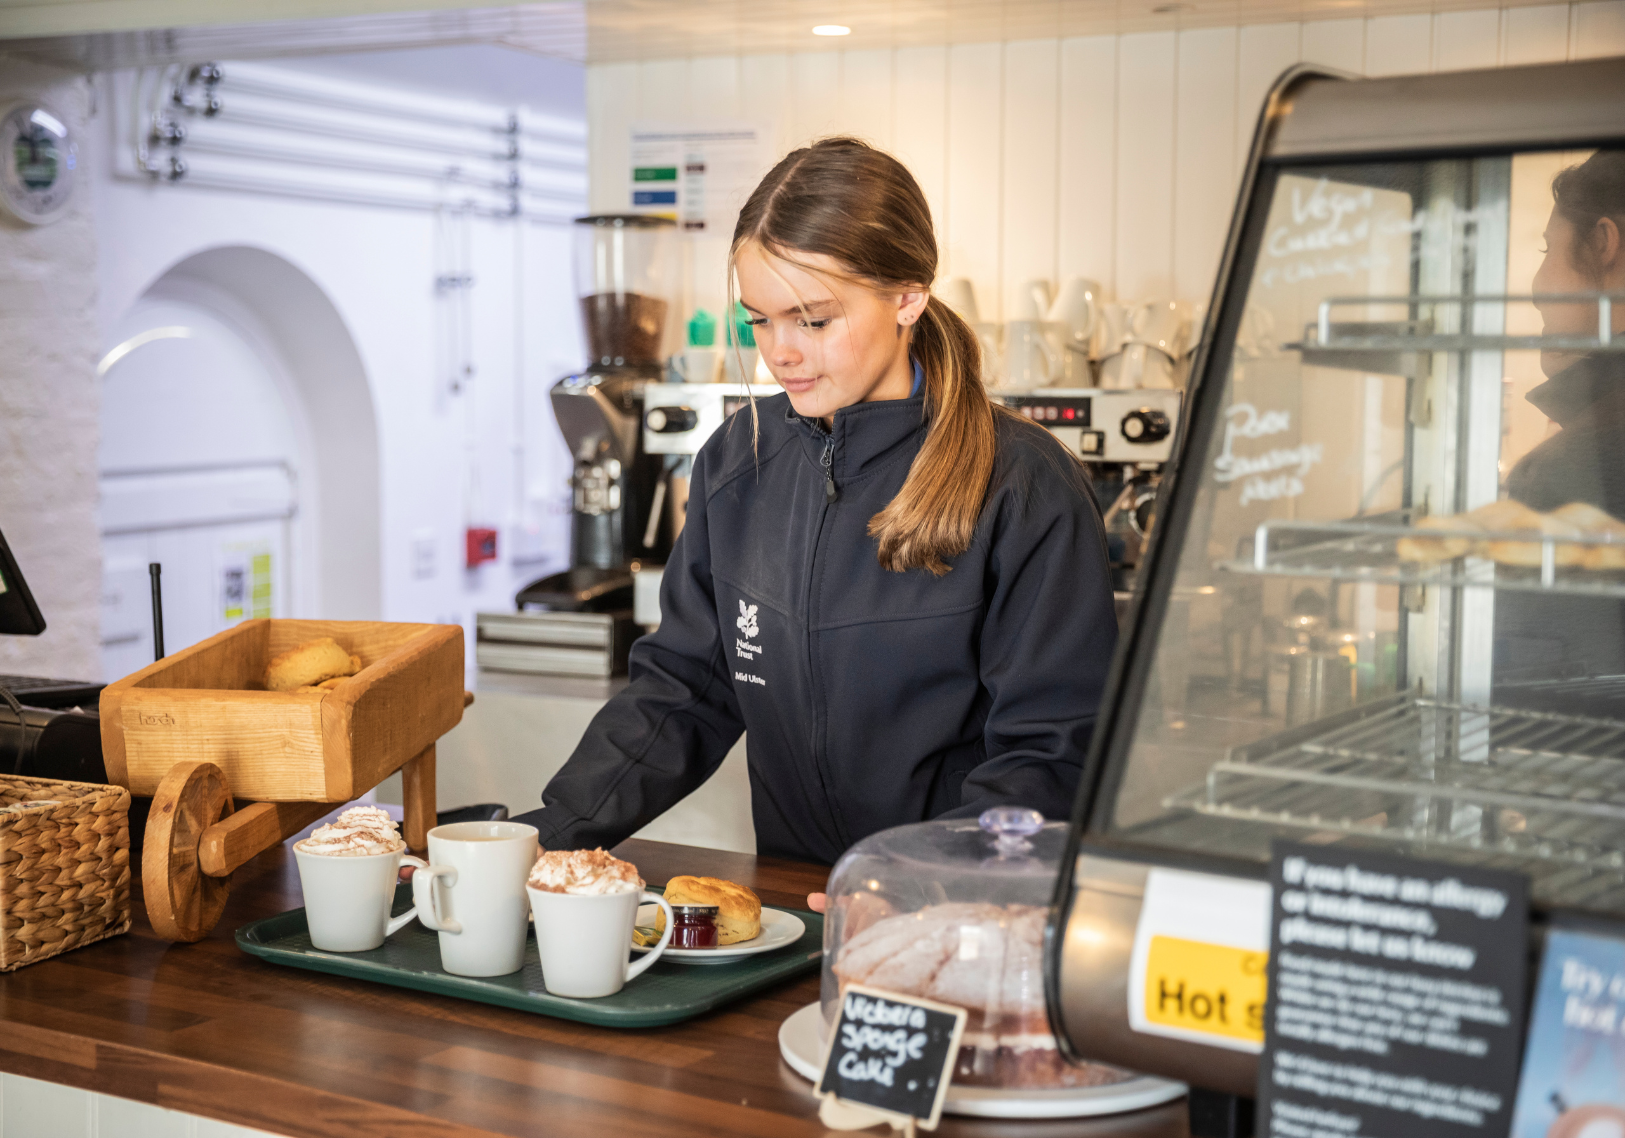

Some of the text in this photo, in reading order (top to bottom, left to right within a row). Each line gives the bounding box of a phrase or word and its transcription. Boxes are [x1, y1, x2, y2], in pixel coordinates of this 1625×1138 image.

[737, 638, 762, 654] National
[736, 647, 753, 660] Trust
[735, 672, 747, 682] Mid
[1158, 977, 1229, 1026] Hot
